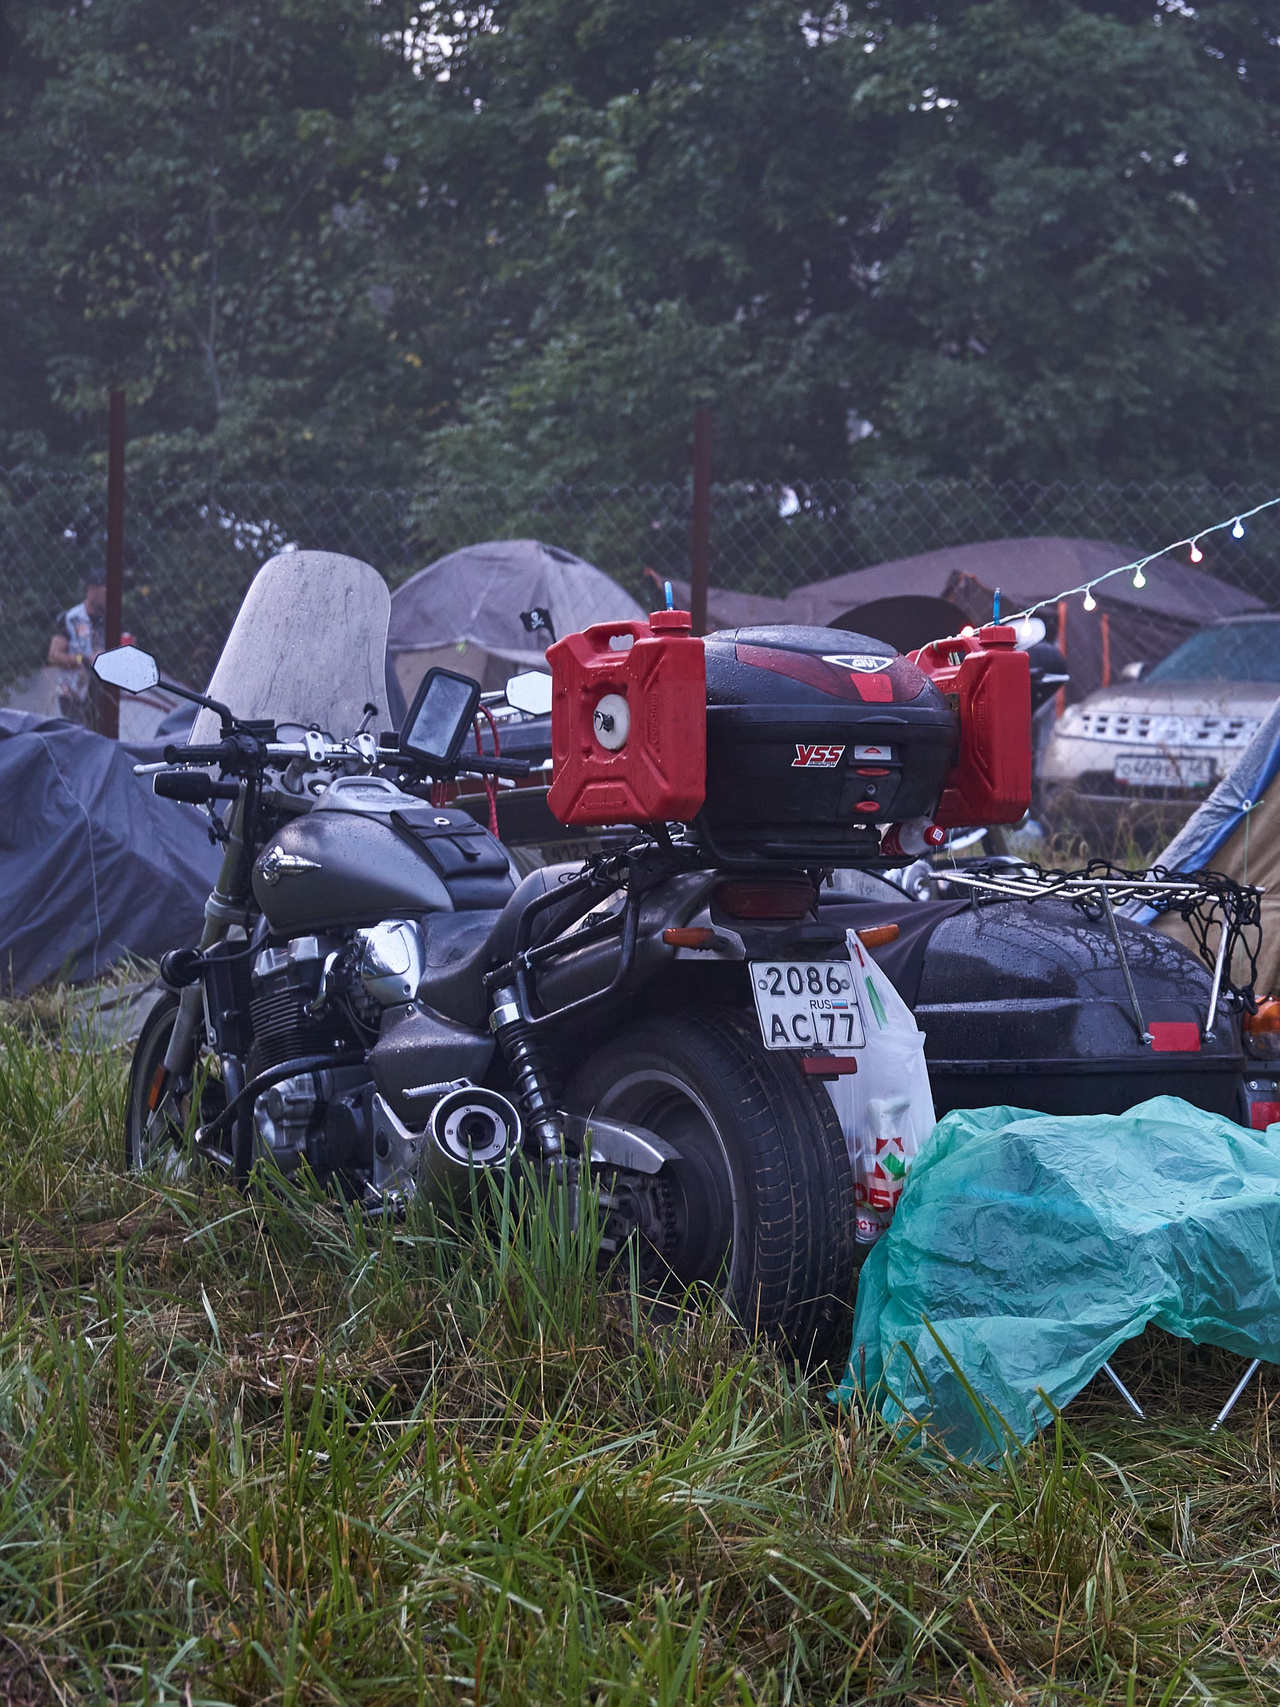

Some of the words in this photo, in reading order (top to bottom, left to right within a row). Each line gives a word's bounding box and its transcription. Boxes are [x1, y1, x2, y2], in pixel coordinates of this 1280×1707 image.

[766, 966, 842, 996] 2086
[809, 1000, 832, 1010] RUS
[820, 1013, 854, 1042] 77
